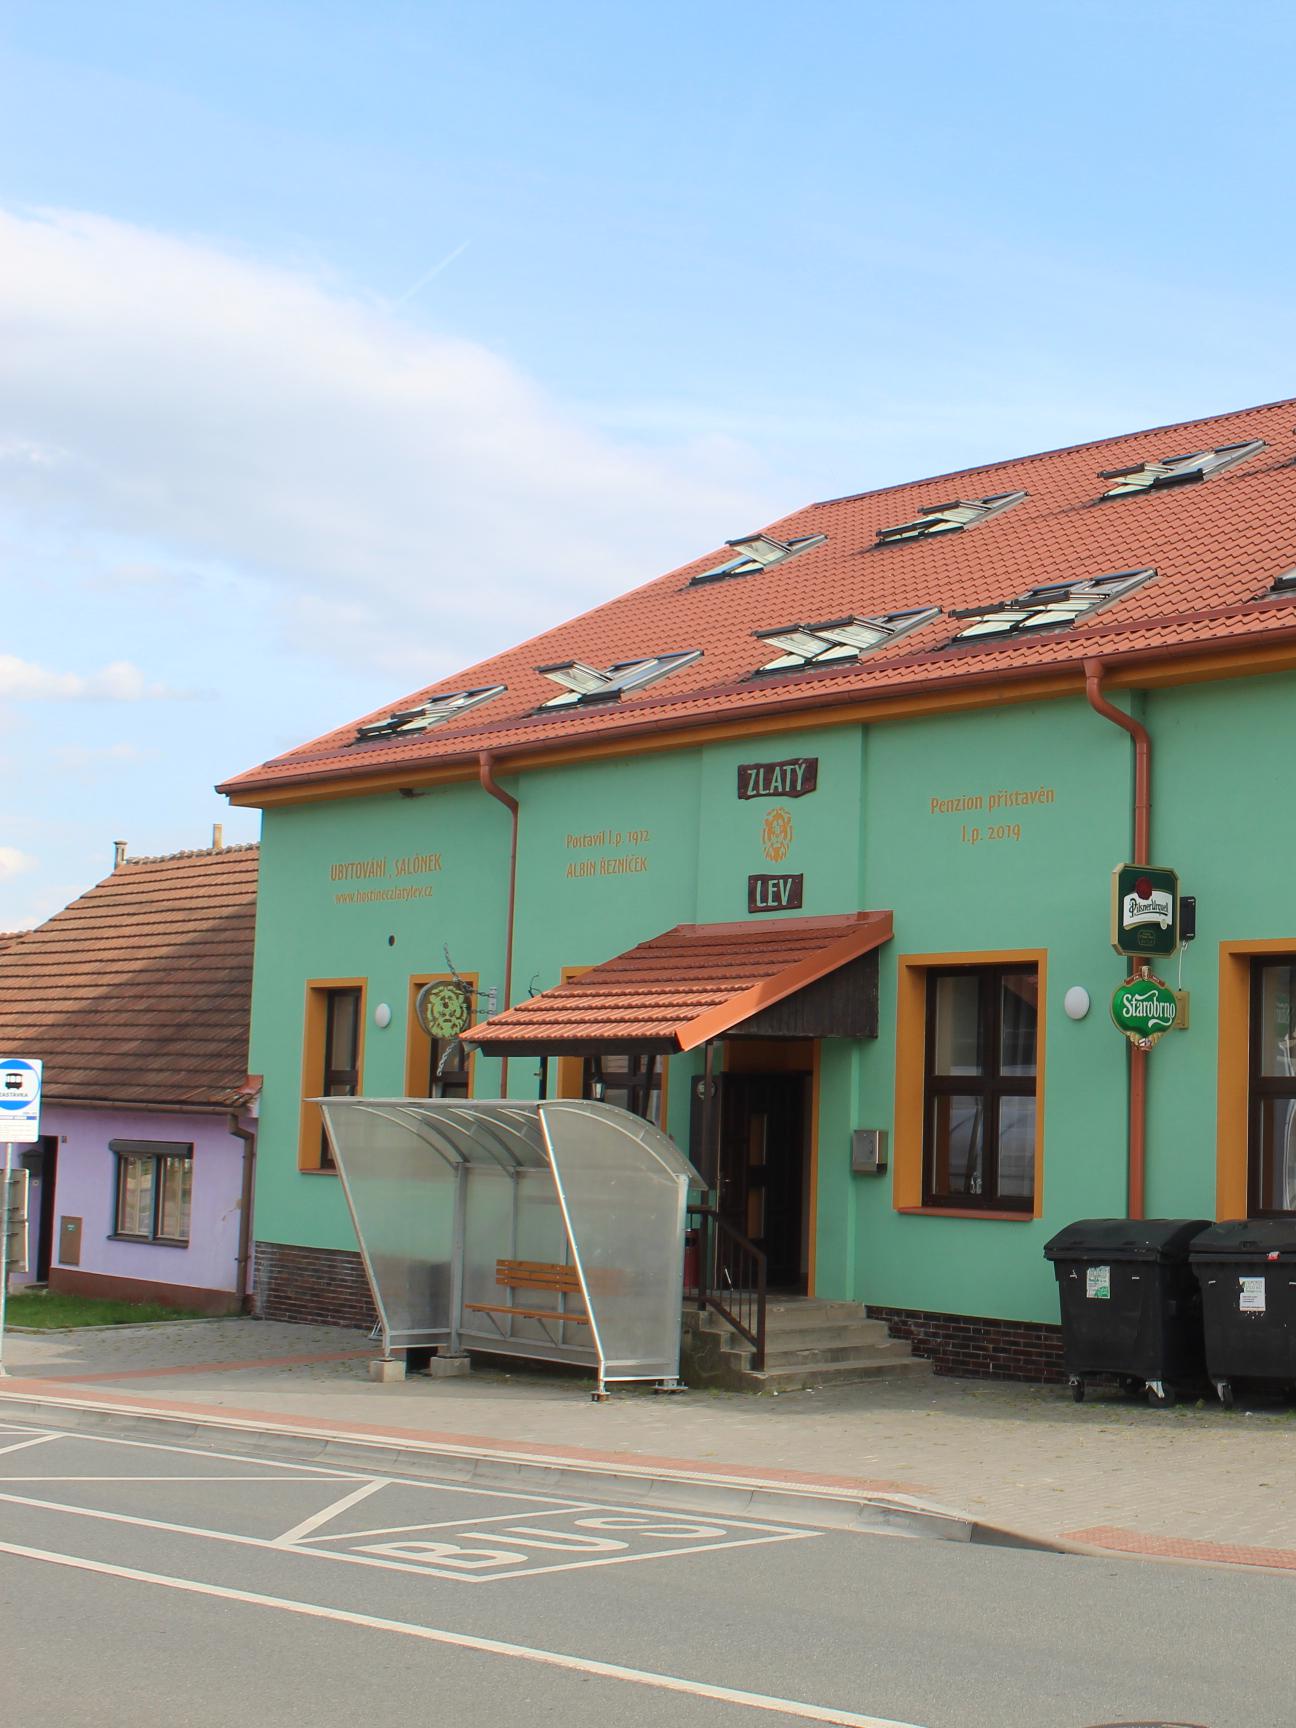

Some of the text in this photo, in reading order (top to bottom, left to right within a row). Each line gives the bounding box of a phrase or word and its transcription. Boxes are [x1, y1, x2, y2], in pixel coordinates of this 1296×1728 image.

[747, 759, 807, 796] ZLATÝ
[930, 794, 983, 814] Penzion
[565, 831, 605, 848] Postavil
[987, 823, 1021, 841] 2019
[566, 855, 647, 878] ALBÍN ŘEZNÍČEK
[756, 878, 792, 907] LEV
[1128, 897, 1152, 918] Pilsner
[1122, 990, 1176, 1028] Starobrno
[350, 1517, 728, 1569] BUS
